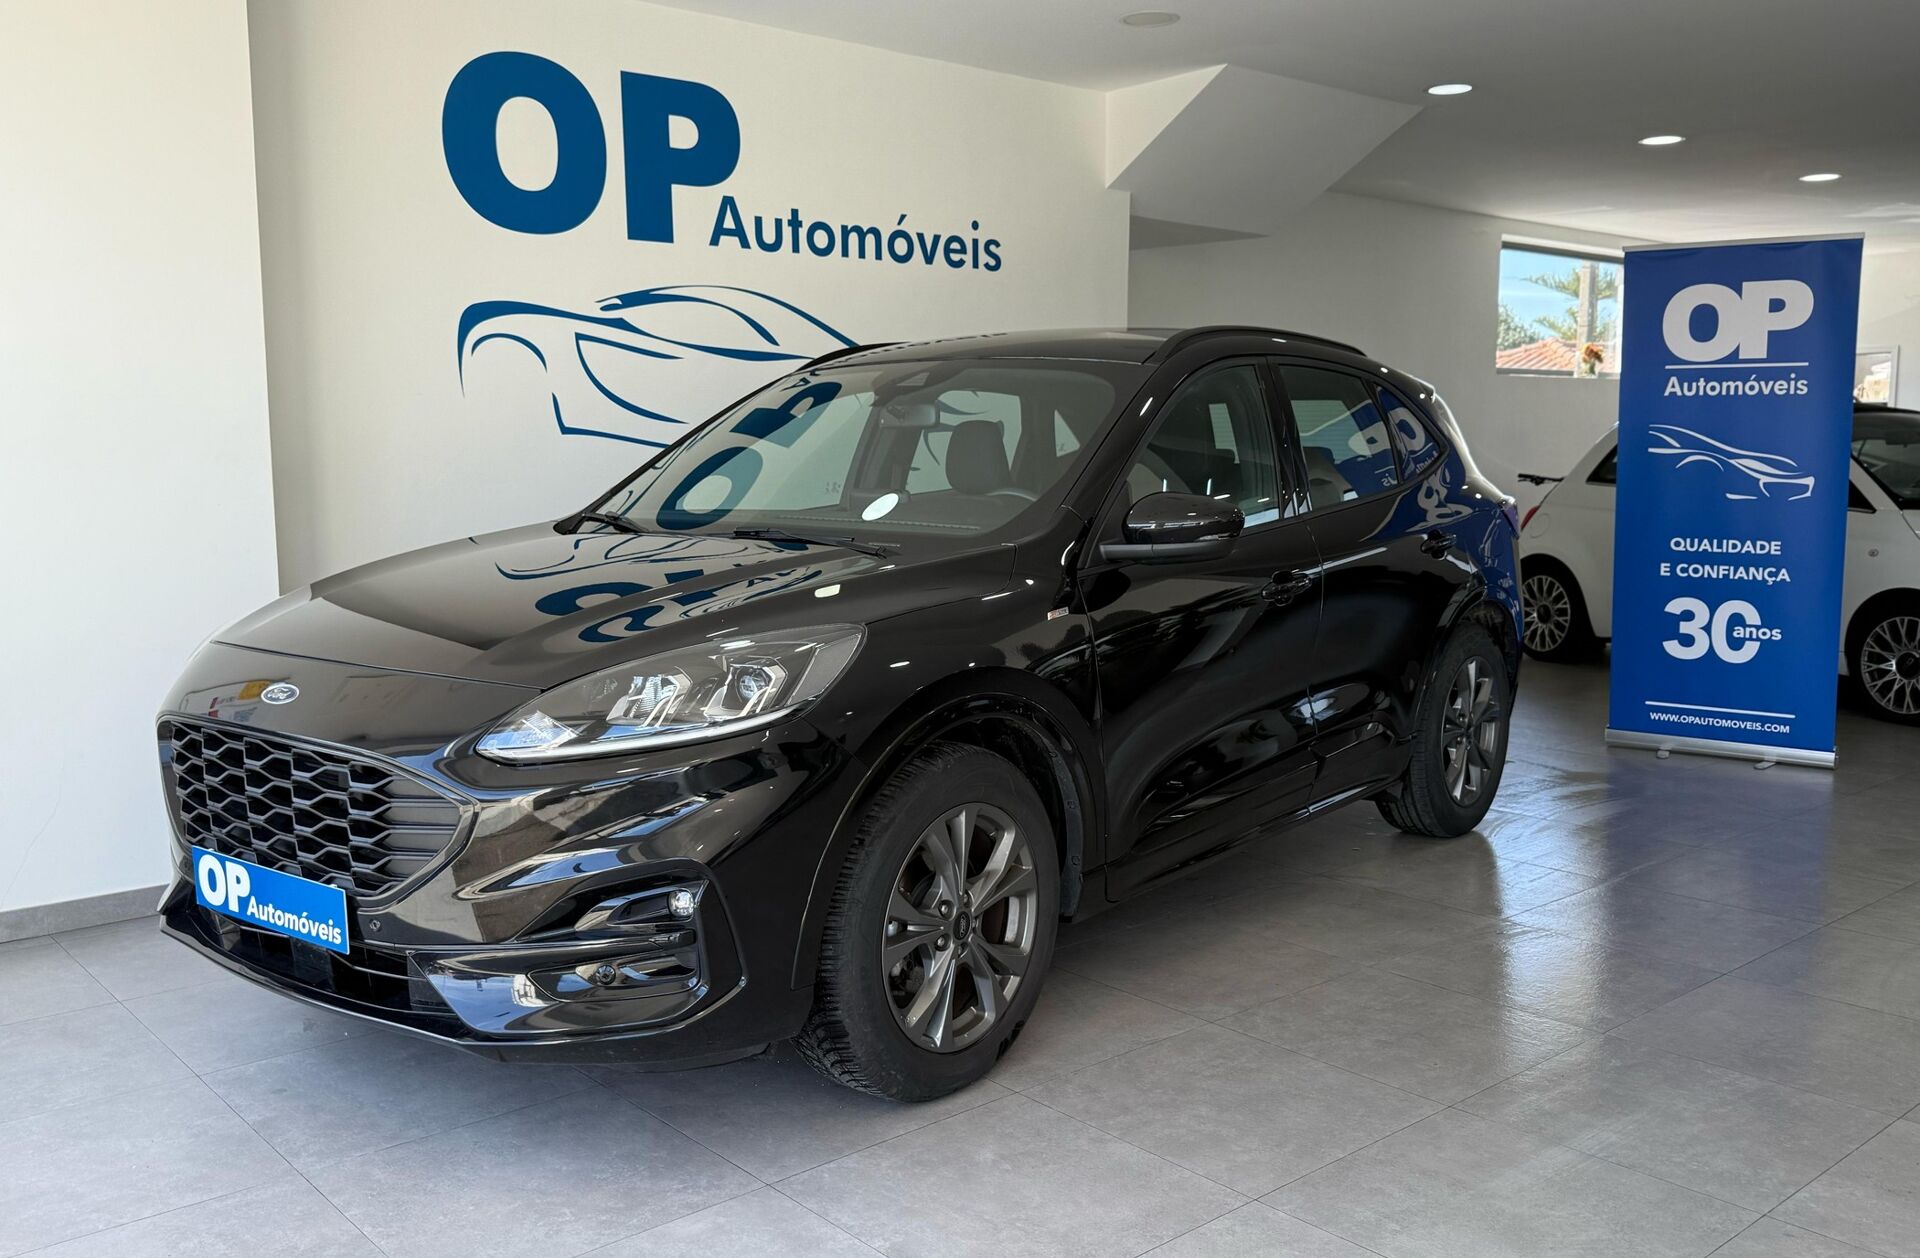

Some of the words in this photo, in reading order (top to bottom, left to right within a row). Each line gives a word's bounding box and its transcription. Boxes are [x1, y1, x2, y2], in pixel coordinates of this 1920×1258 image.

[442, 51, 741, 244] OP
[709, 195, 1002, 272] Automóveis
[1662, 279, 1814, 362] OP
[1664, 373, 1808, 396] Automóveis
[1670, 537, 1782, 555] QUALIDADE
[1660, 563, 1671, 577] E
[1676, 563, 1791, 585] CONFIANÇA
[1662, 597, 1761, 664] 30
[1732, 625, 1782, 641] anos
[1650, 711, 1790, 733] WWW.OPAUTOMOVEIS.COM
[198, 854, 250, 913] OP
[246, 896, 342, 945] Automóveis
